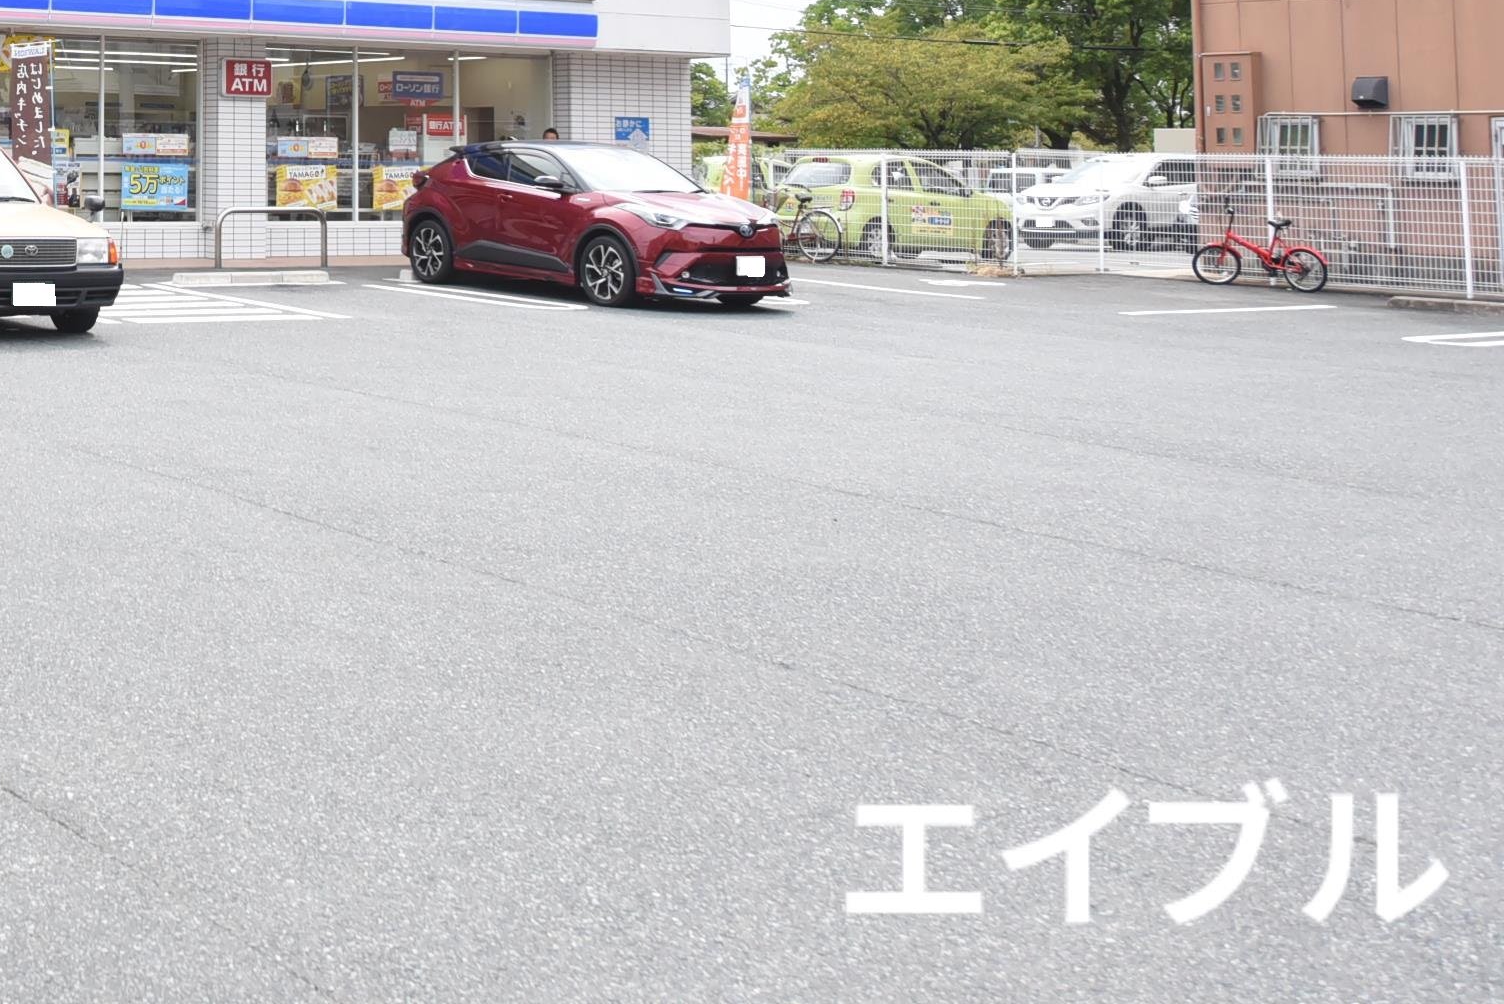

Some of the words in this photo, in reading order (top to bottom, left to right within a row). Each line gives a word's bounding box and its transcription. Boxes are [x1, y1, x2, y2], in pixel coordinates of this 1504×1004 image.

[233, 62, 266, 77] 銀行
[230, 77, 267, 92] ATM
[396, 83, 440, 93] ローソン銀行
[409, 99, 426, 107] ATM
[288, 170, 320, 178] TAMAGO
[129, 174, 160, 195] 5万
